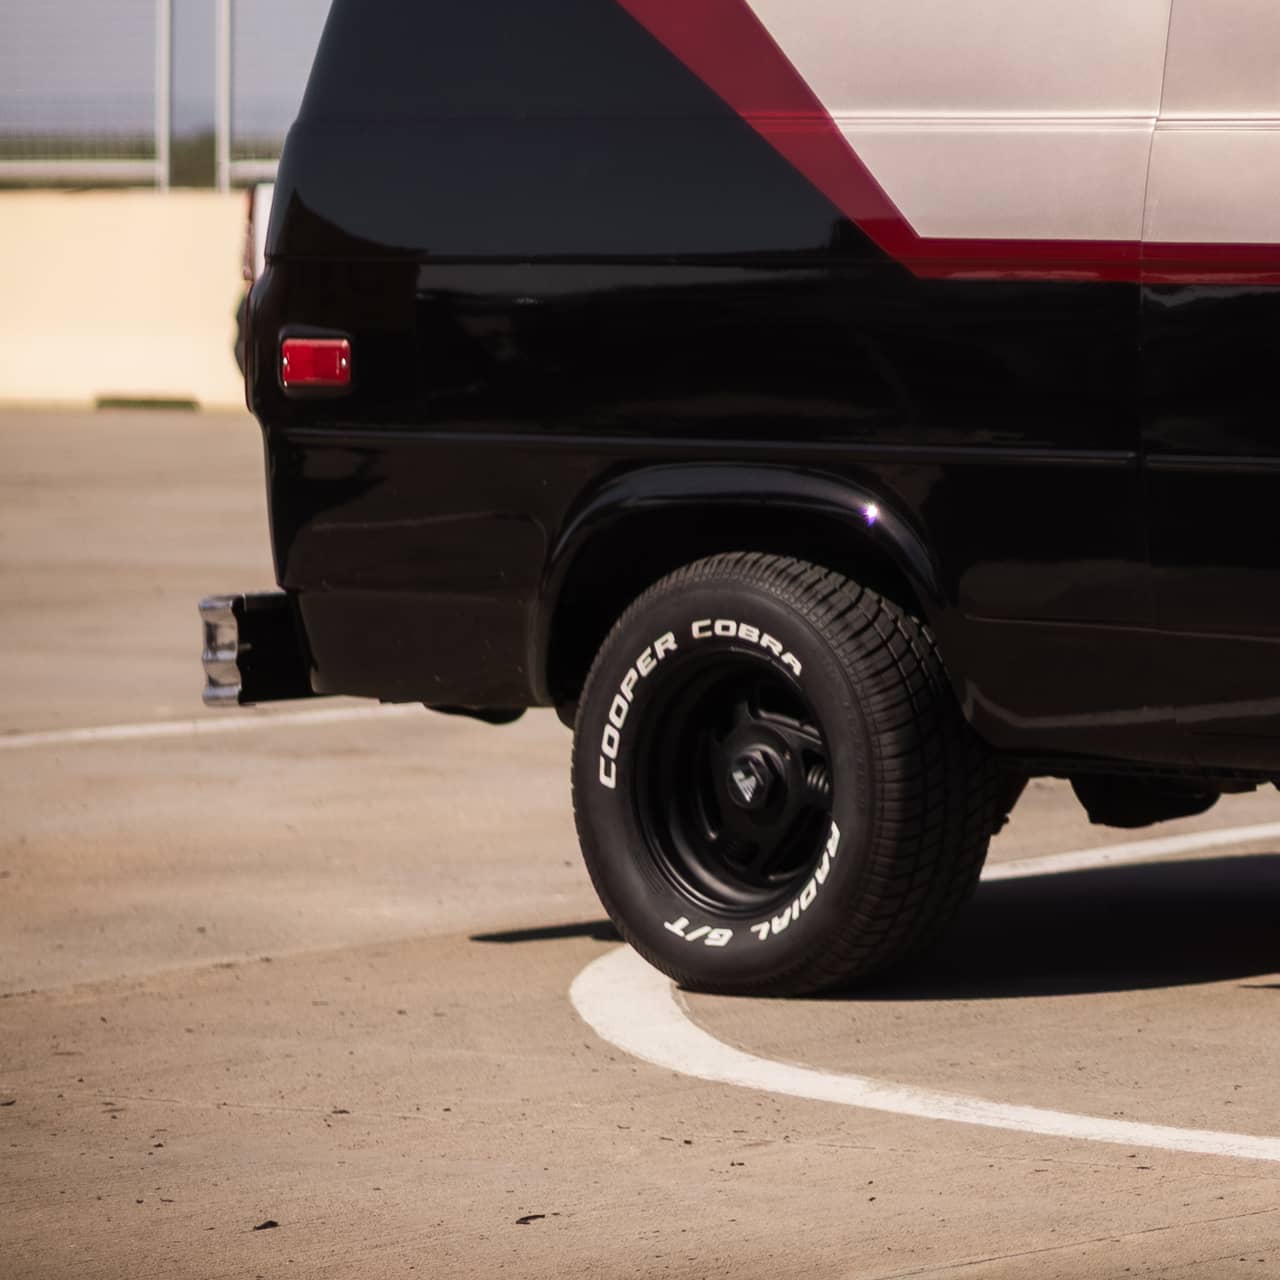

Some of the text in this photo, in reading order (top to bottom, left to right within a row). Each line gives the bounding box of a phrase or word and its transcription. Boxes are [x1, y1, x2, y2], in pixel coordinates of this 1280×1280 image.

[599, 619, 802, 789] COOPER COBRA
[663, 820, 840, 947] RADIAL G/T
